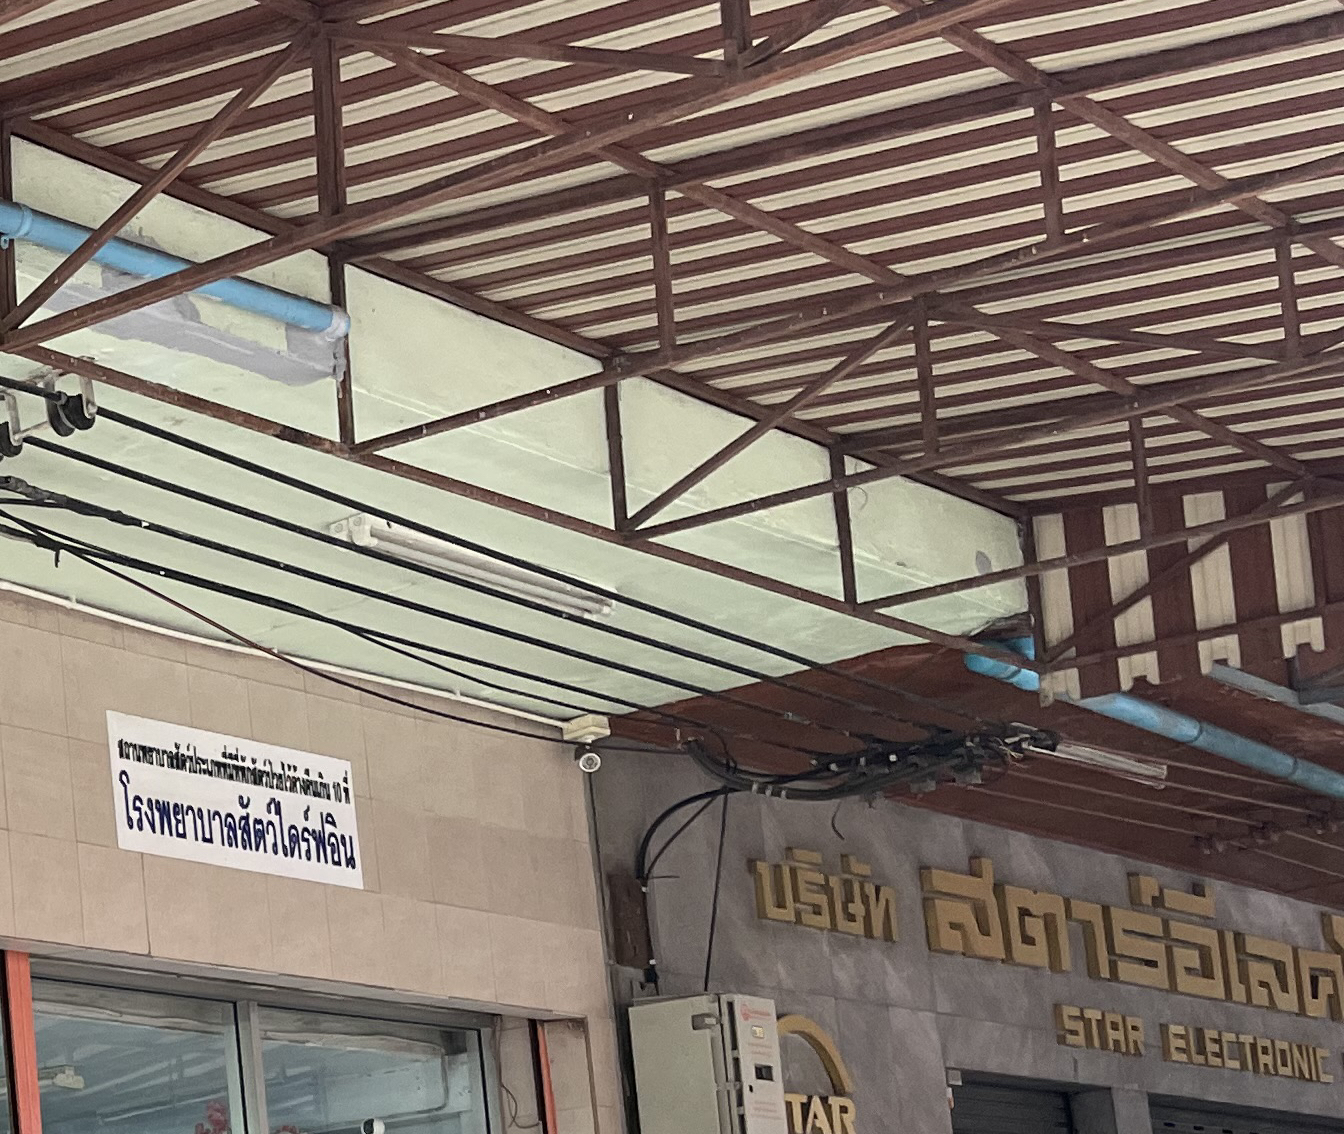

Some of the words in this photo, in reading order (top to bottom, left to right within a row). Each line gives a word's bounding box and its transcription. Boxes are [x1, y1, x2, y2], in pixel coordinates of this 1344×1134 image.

[118, 769, 357, 870] โรงพยาบาลสัตว์ไดร์ฟอิน
[750, 846, 898, 942] บริษัท
[1055, 1003, 1145, 1057] STAR
[1160, 1022, 1335, 1084] ELECTRONIC
